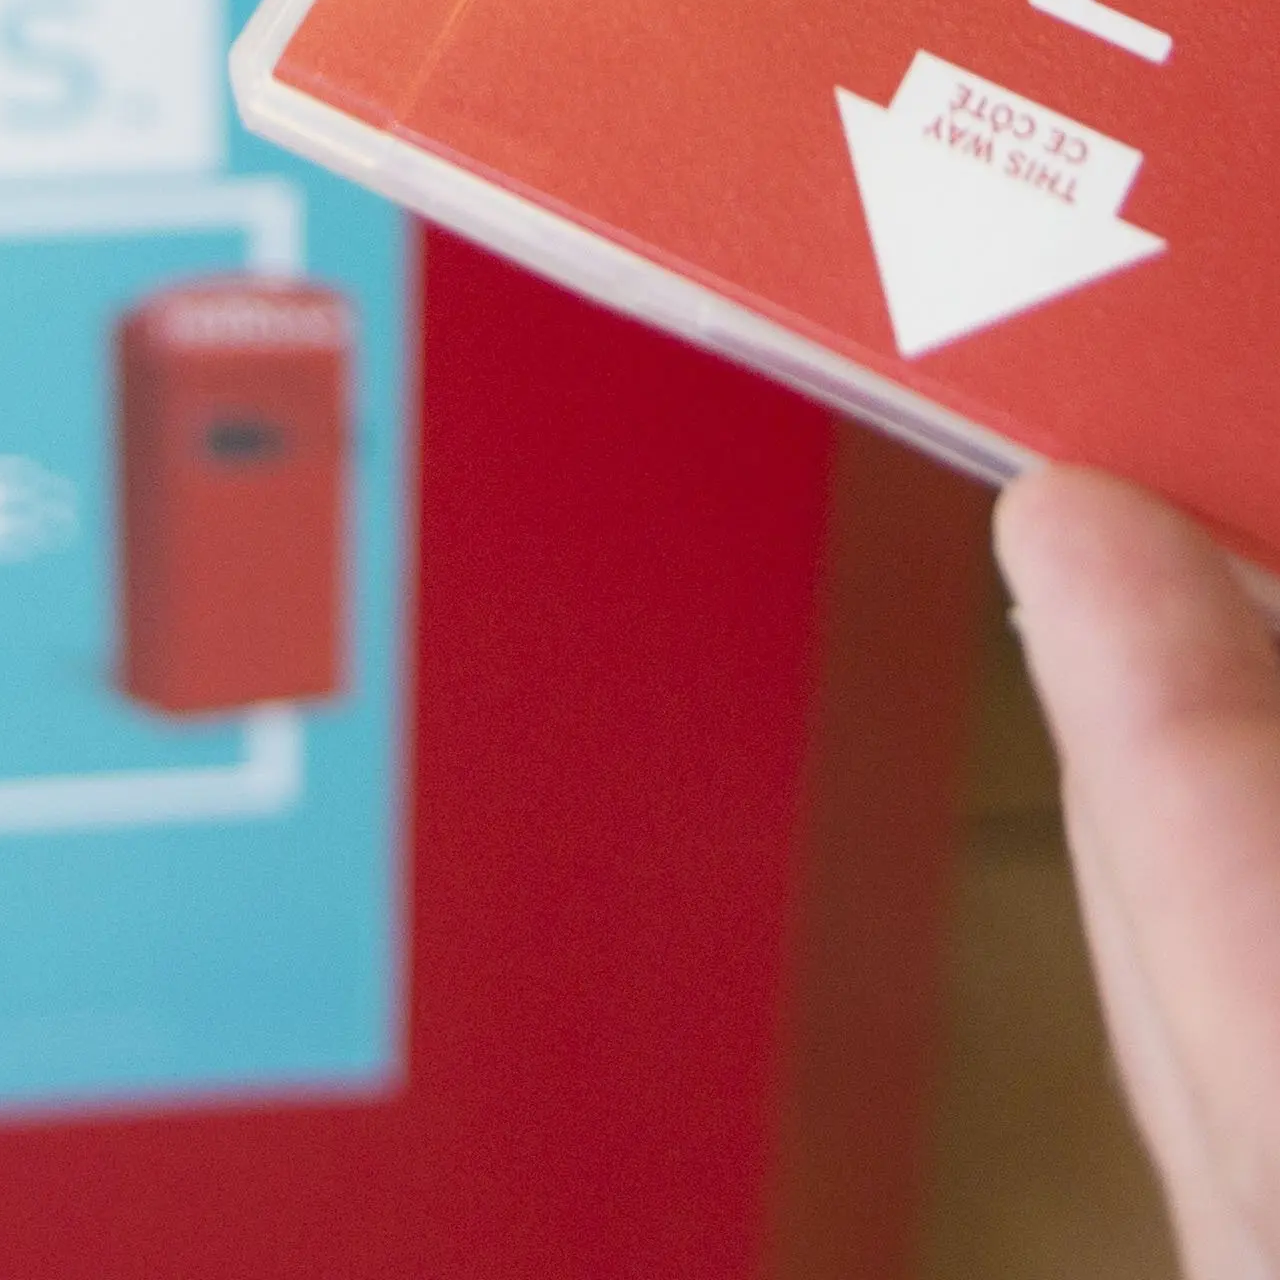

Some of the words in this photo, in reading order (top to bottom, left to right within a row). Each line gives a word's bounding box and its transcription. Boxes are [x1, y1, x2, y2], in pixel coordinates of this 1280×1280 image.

[923, 115, 993, 164] WAY
[1043, 127, 1088, 164] CE
[1004, 148, 1077, 206] THIS
